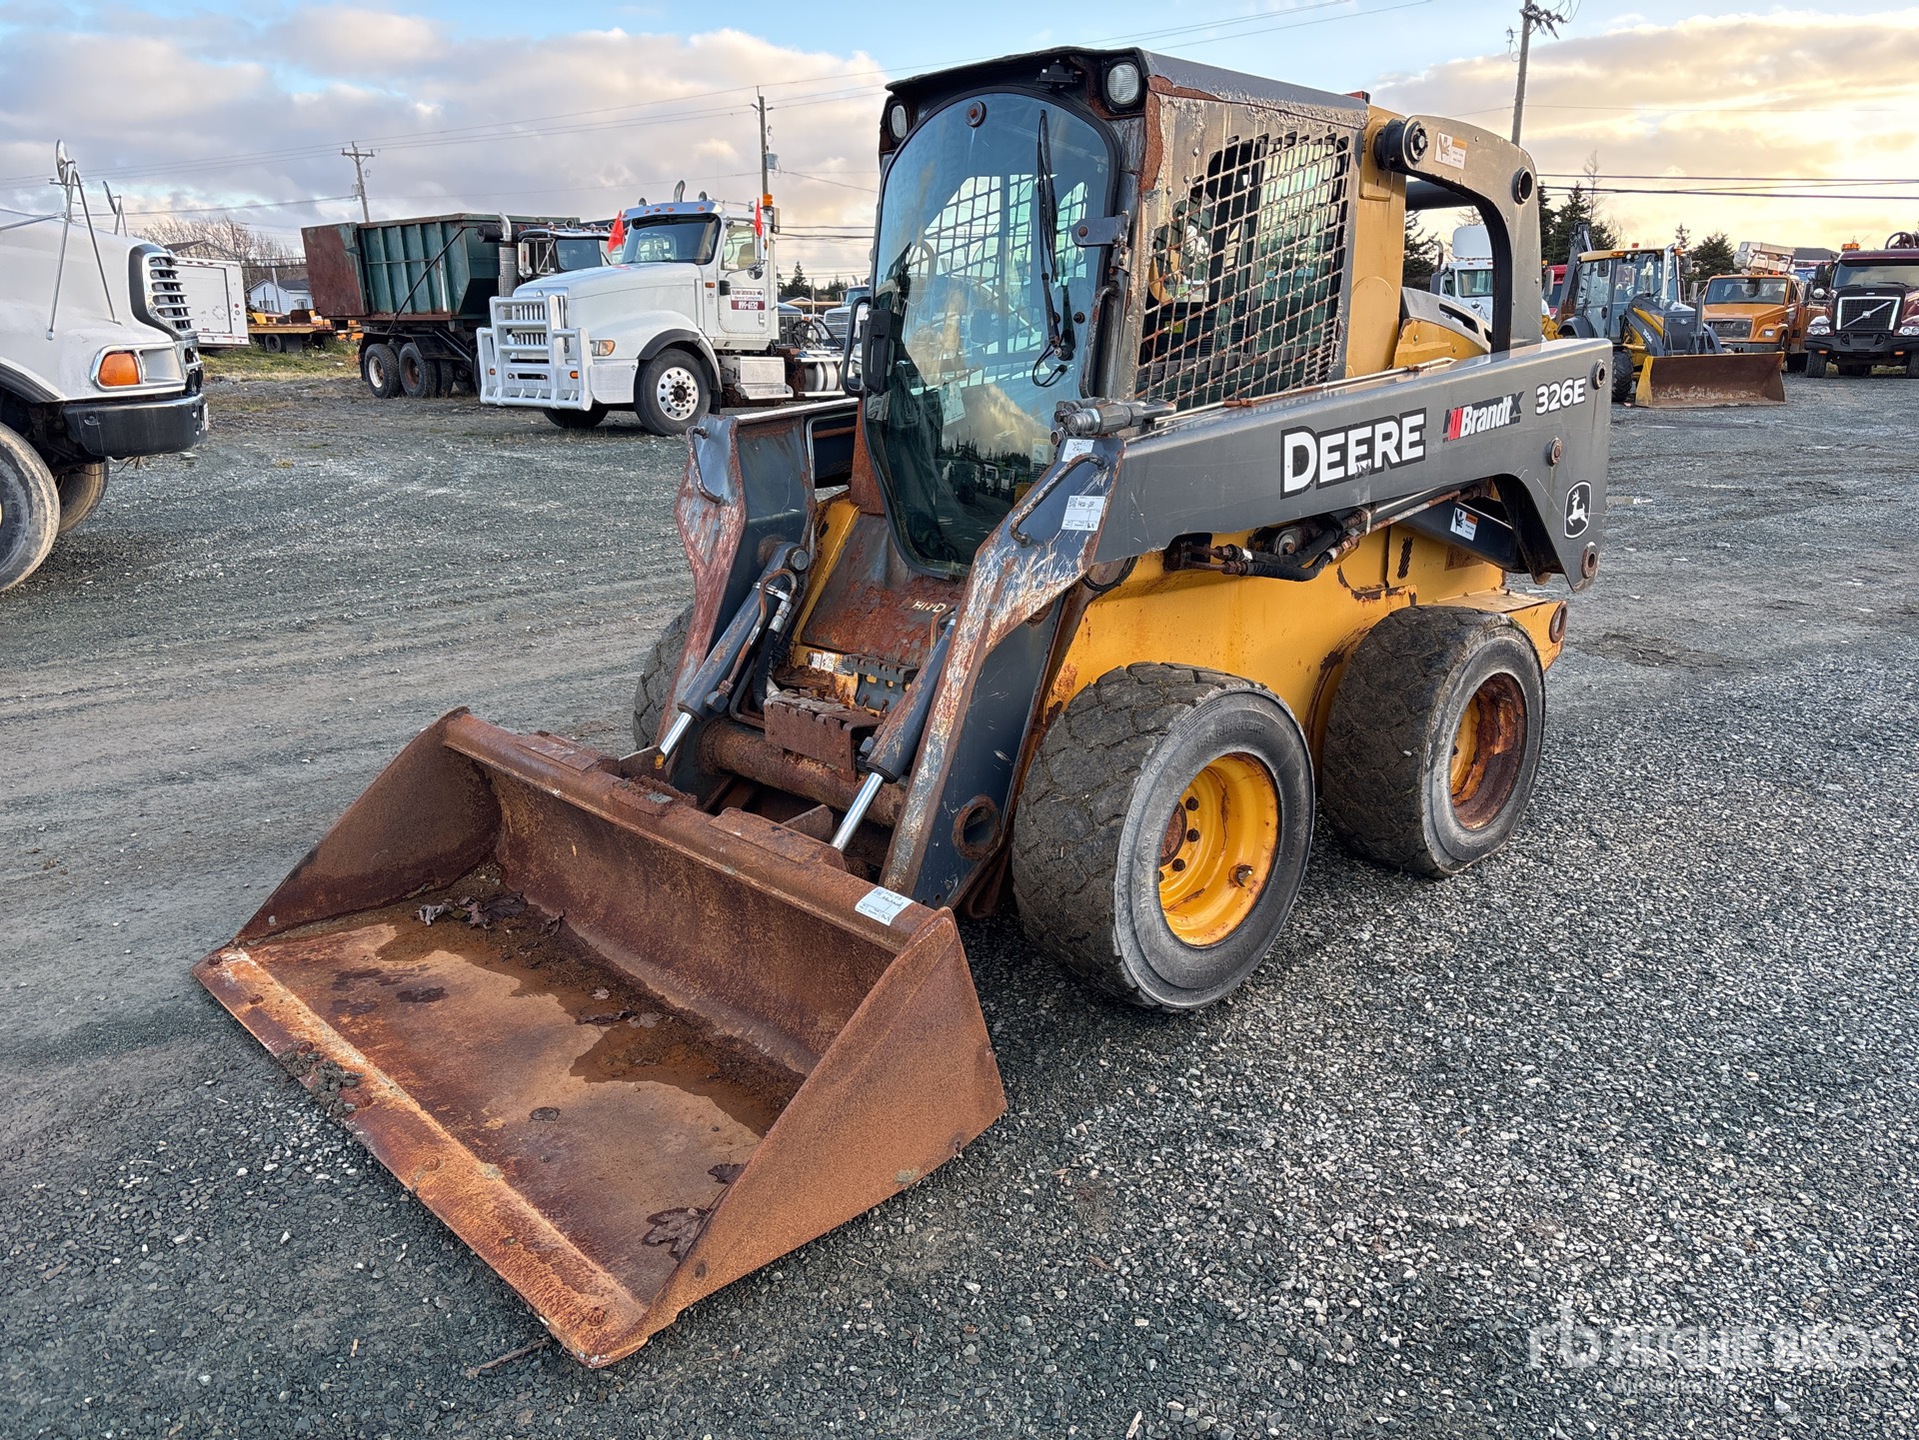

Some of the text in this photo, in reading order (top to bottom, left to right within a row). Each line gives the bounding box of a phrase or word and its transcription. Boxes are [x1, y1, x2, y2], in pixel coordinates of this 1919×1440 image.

[1459, 395, 1513, 438] Brandt
[1536, 377, 1586, 414] 326E
[1283, 412, 1425, 494] DEERE
